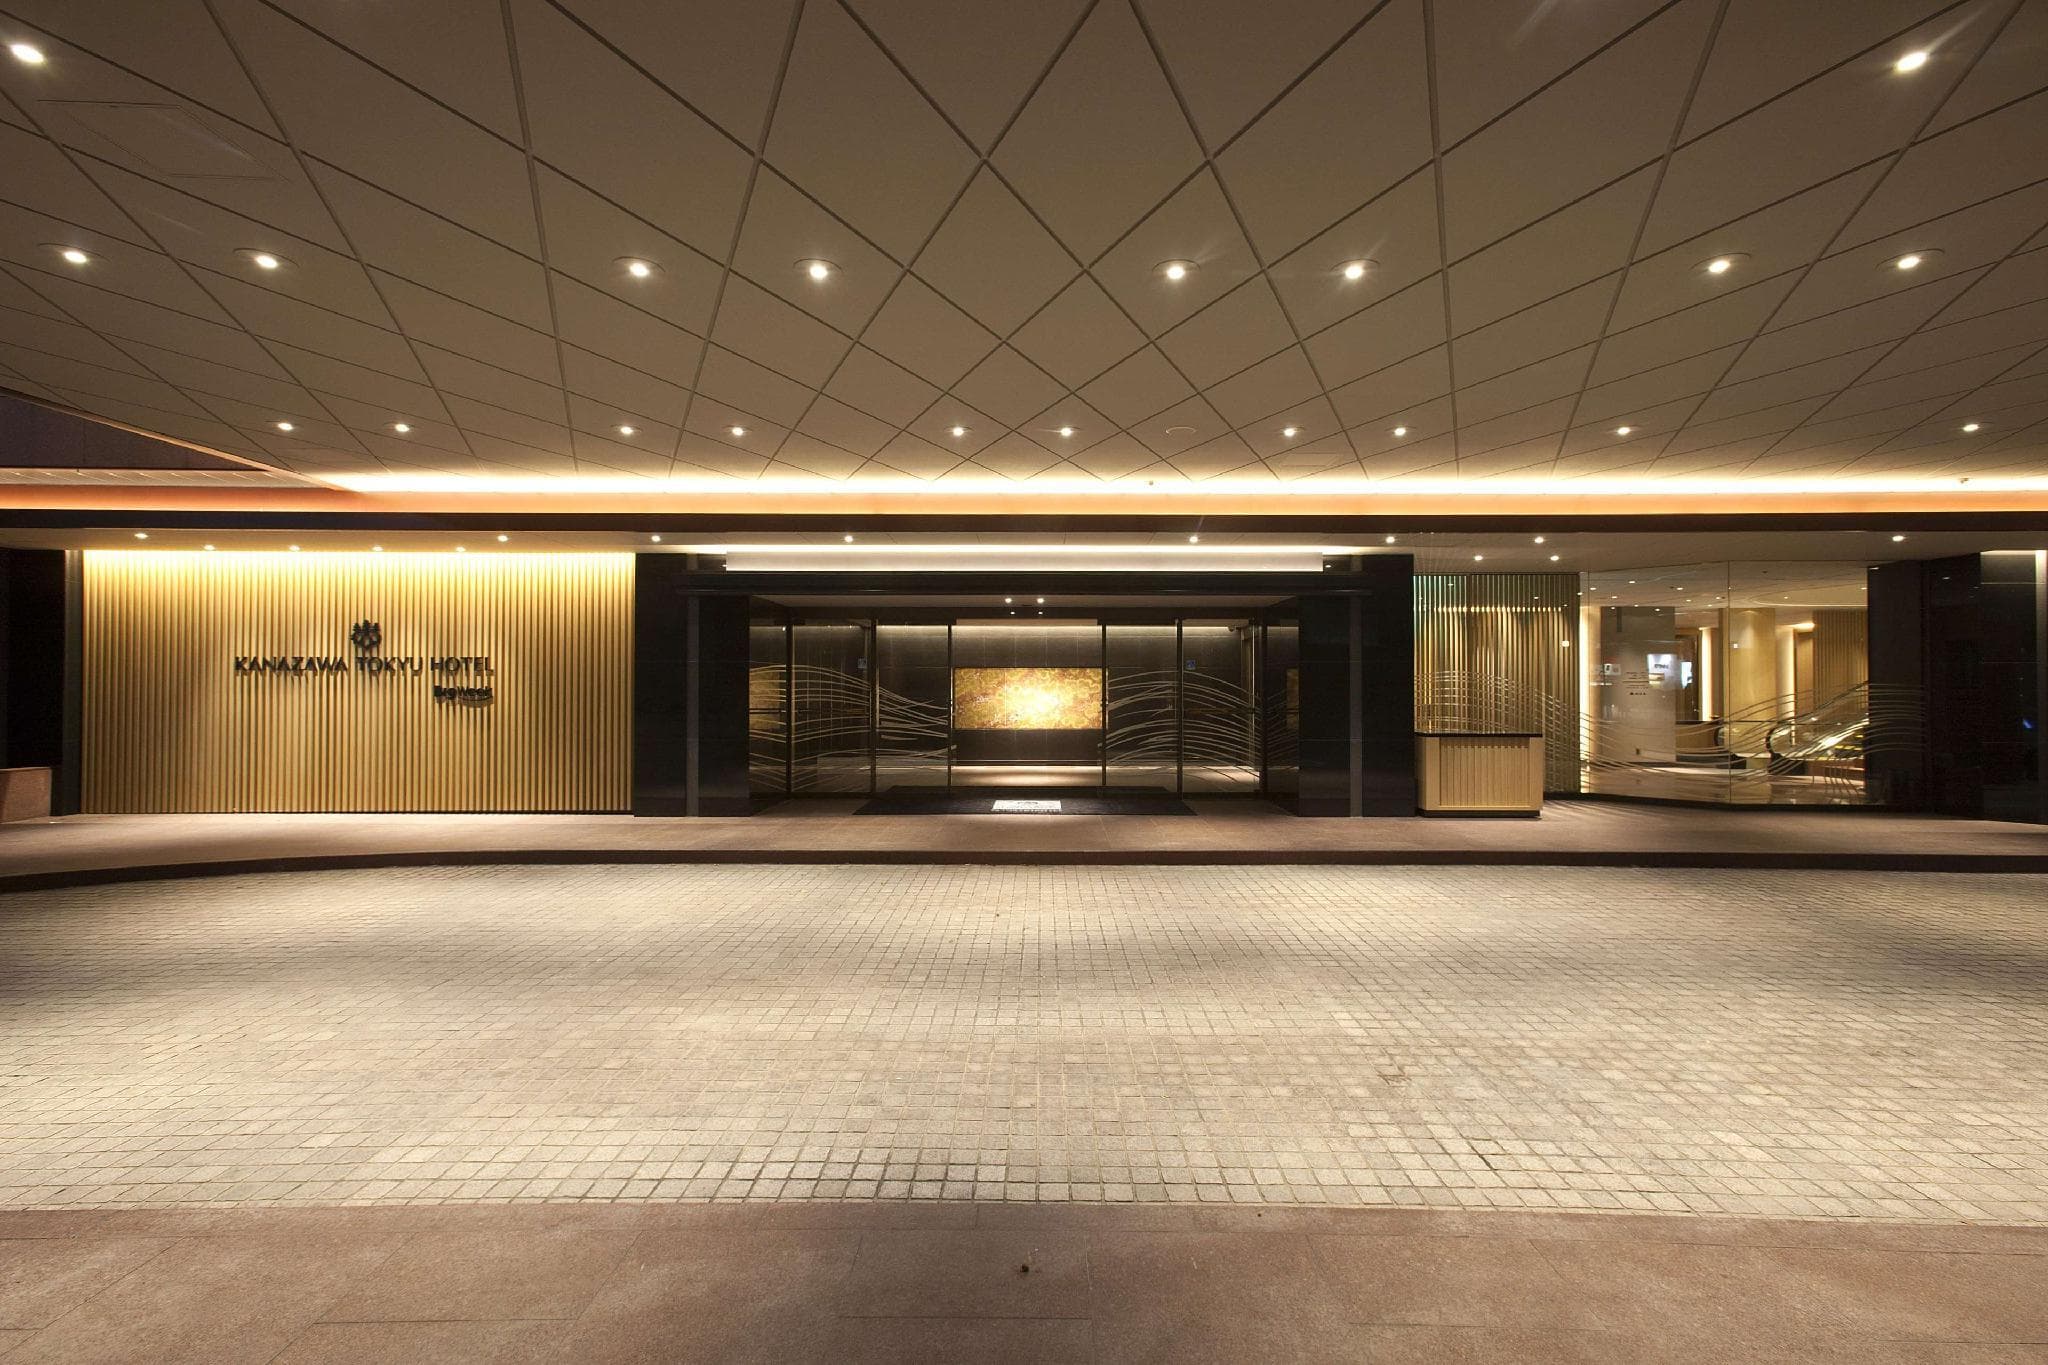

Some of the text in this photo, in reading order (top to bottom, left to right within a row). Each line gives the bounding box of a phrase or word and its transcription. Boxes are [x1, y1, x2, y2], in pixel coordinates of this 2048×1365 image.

[234, 656, 494, 674] KANAZAWA TOKYU HOTEL
